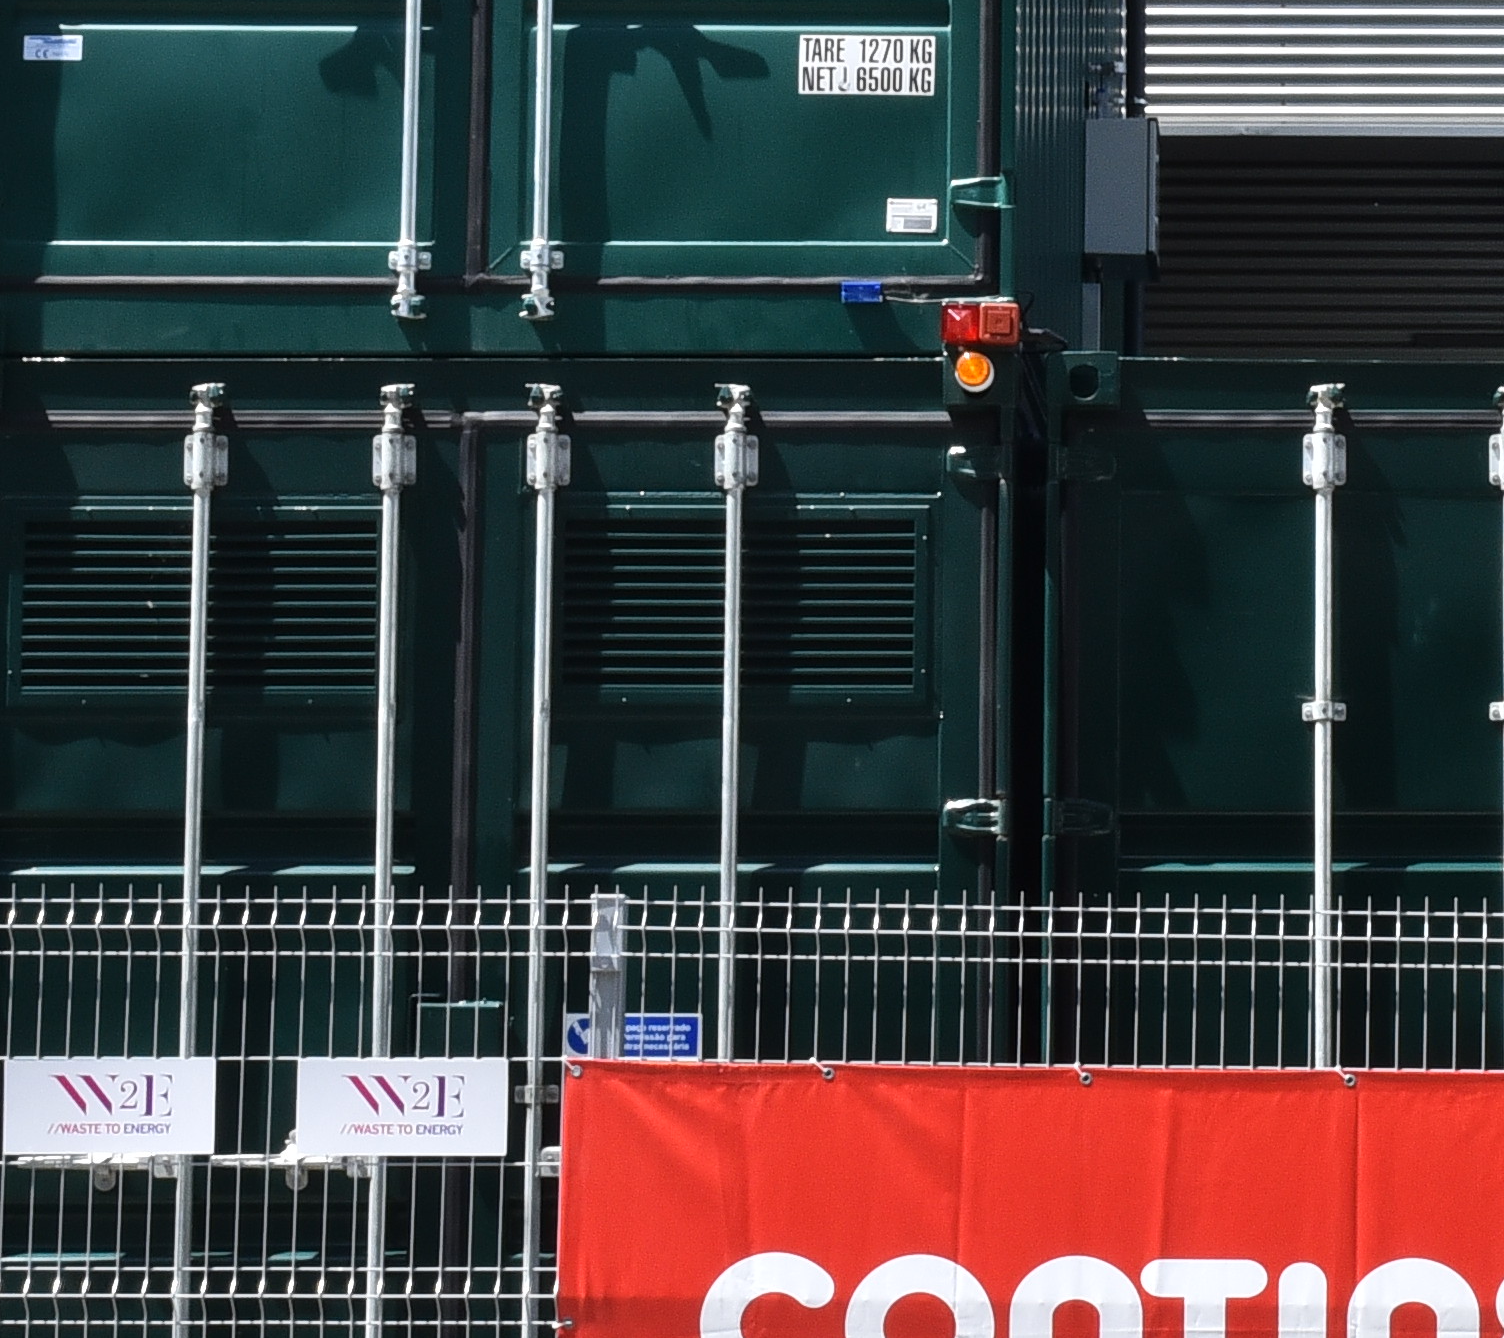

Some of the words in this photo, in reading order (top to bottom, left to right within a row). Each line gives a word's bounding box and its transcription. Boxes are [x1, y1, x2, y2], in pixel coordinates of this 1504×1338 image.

[803, 38, 846, 63] TARE
[859, 38, 903, 64] 1270
[909, 38, 933, 64] KG
[856, 66, 903, 92] 6500
[908, 67, 932, 93] KG
[49, 1073, 173, 1117] W2E
[341, 1075, 466, 1118] W2E
[105, 1123, 120, 1135] TO
[123, 1123, 171, 1135] ENERGY
[397, 1124, 413, 1136] TO
[415, 1124, 464, 1136] ENERGY
